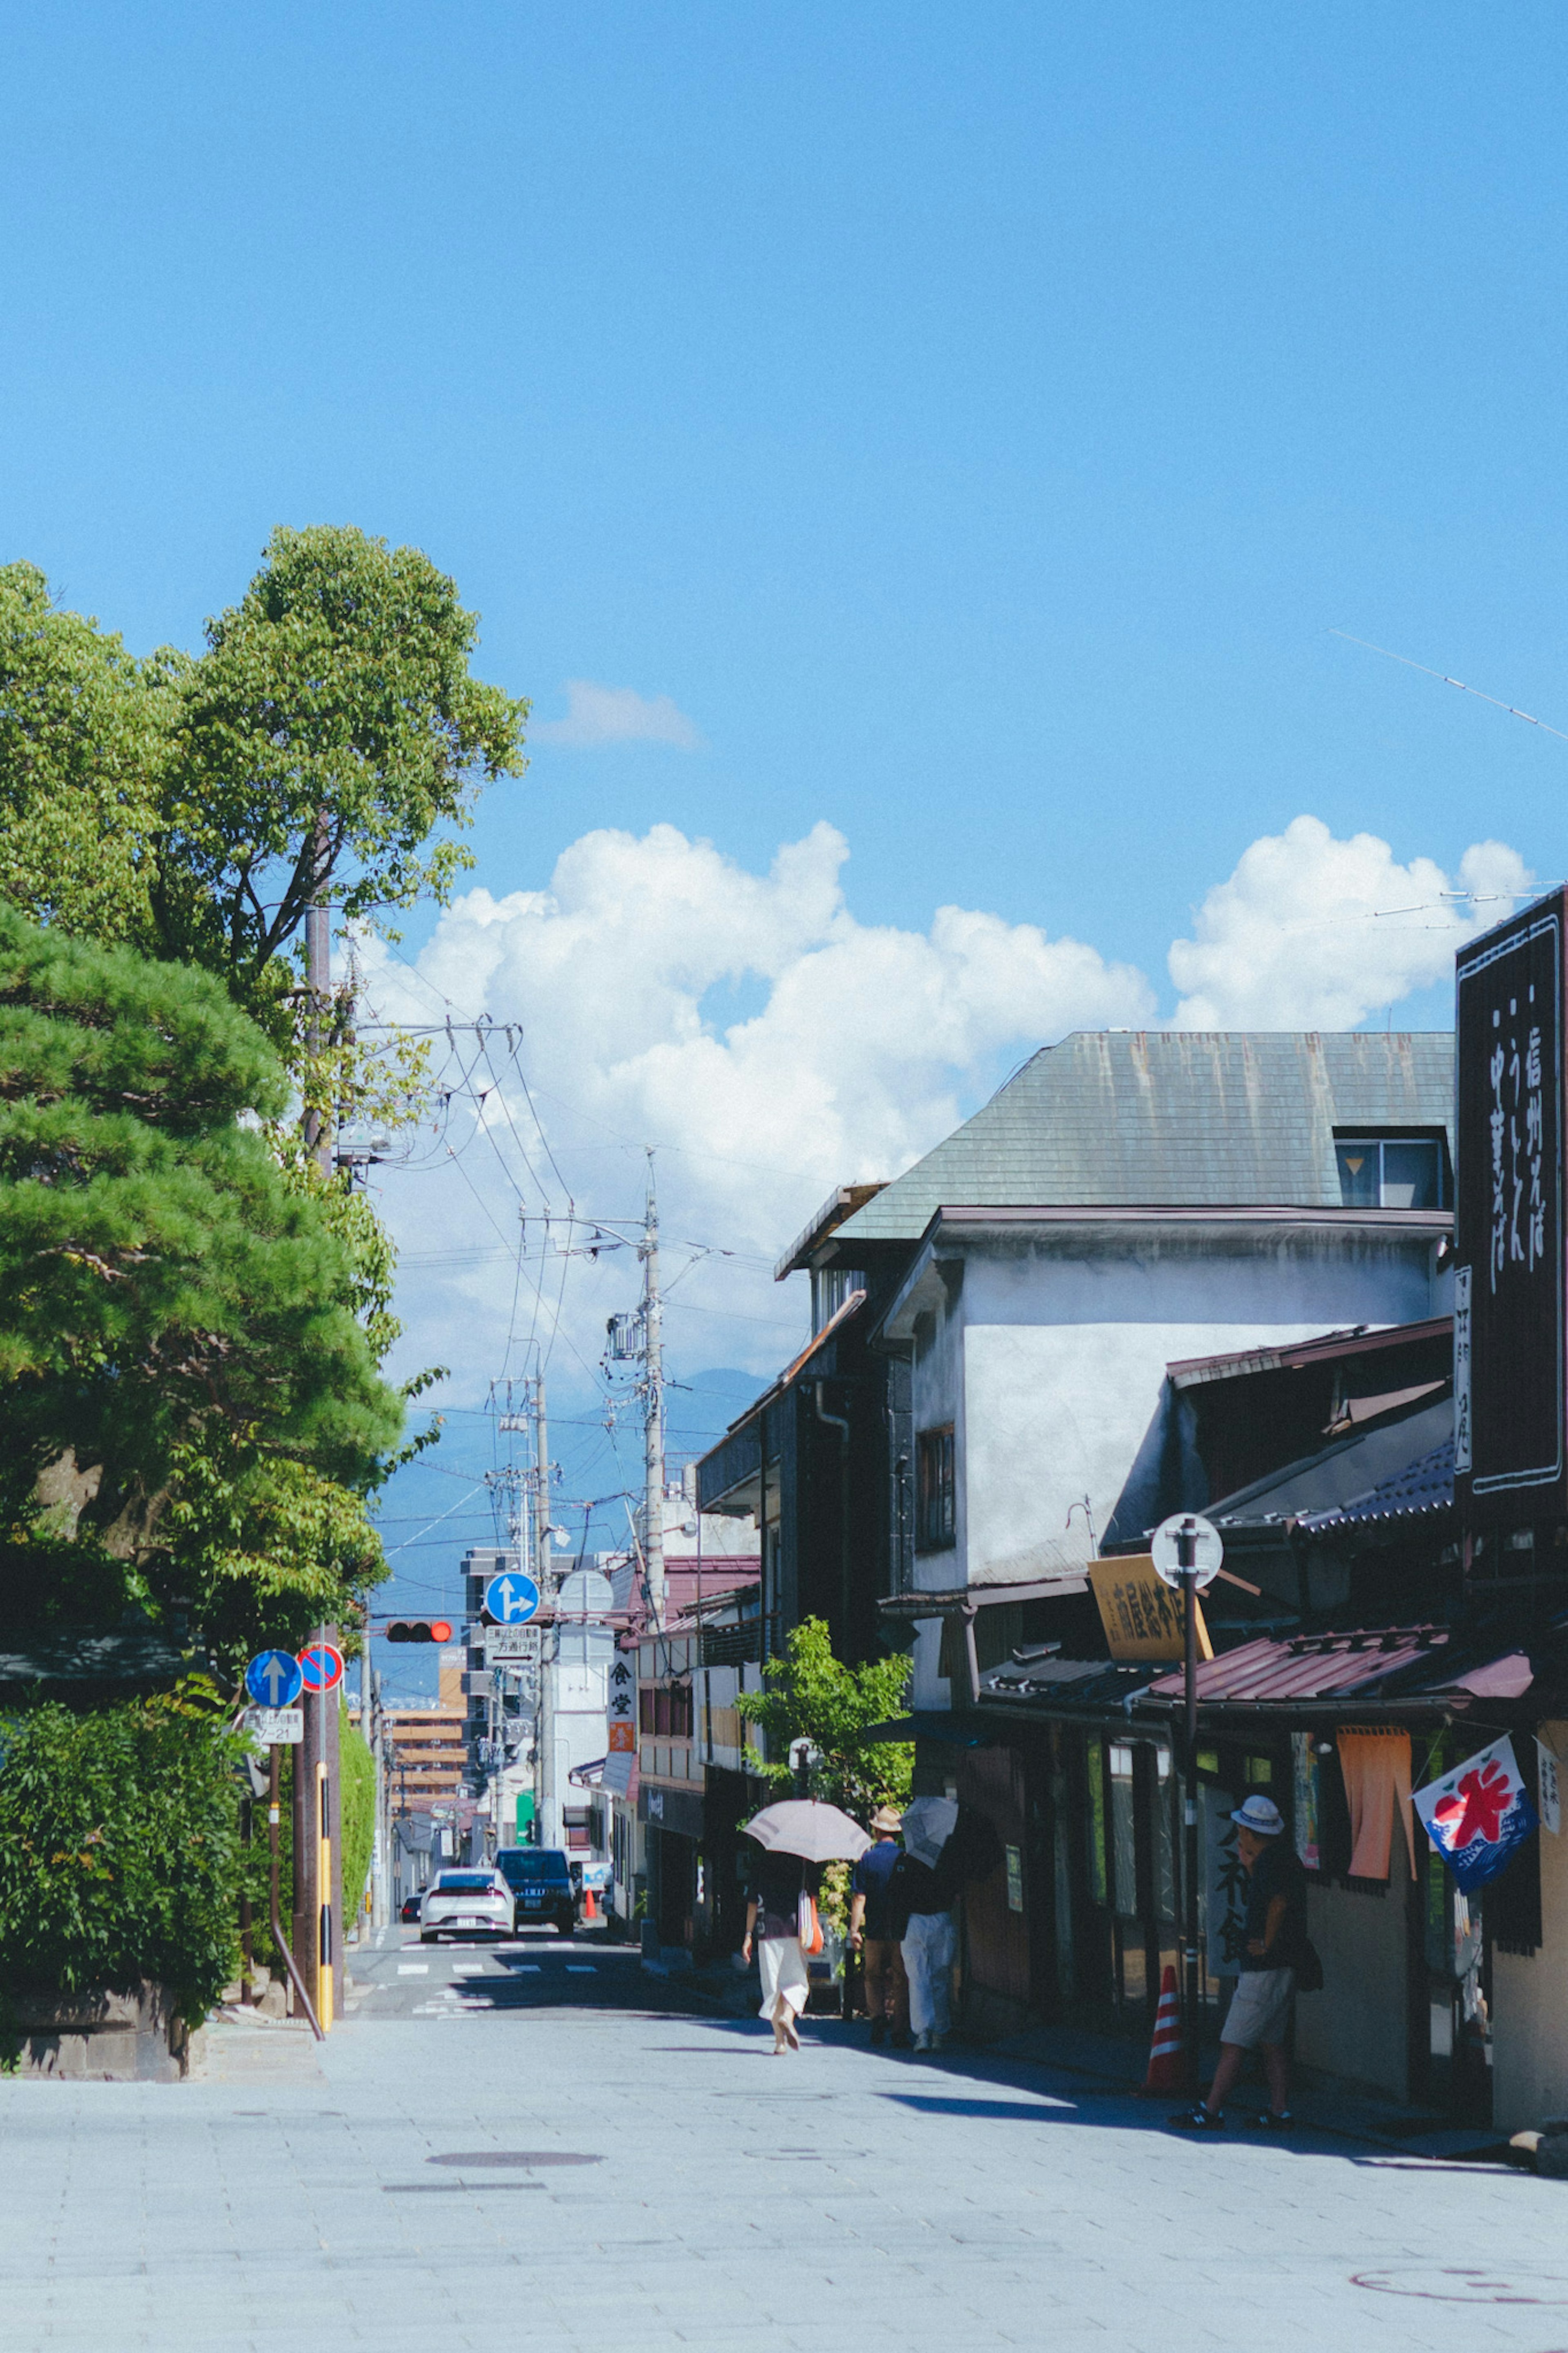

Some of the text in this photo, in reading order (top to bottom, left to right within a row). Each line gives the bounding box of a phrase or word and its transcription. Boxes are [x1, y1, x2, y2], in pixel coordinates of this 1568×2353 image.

[1490, 1043, 1508, 1295] 中華そば
[1509, 1038, 1525, 1261] うどん
[1526, 1027, 1546, 1273] 信州そば
[488, 1641, 538, 1652] 一方通行路
